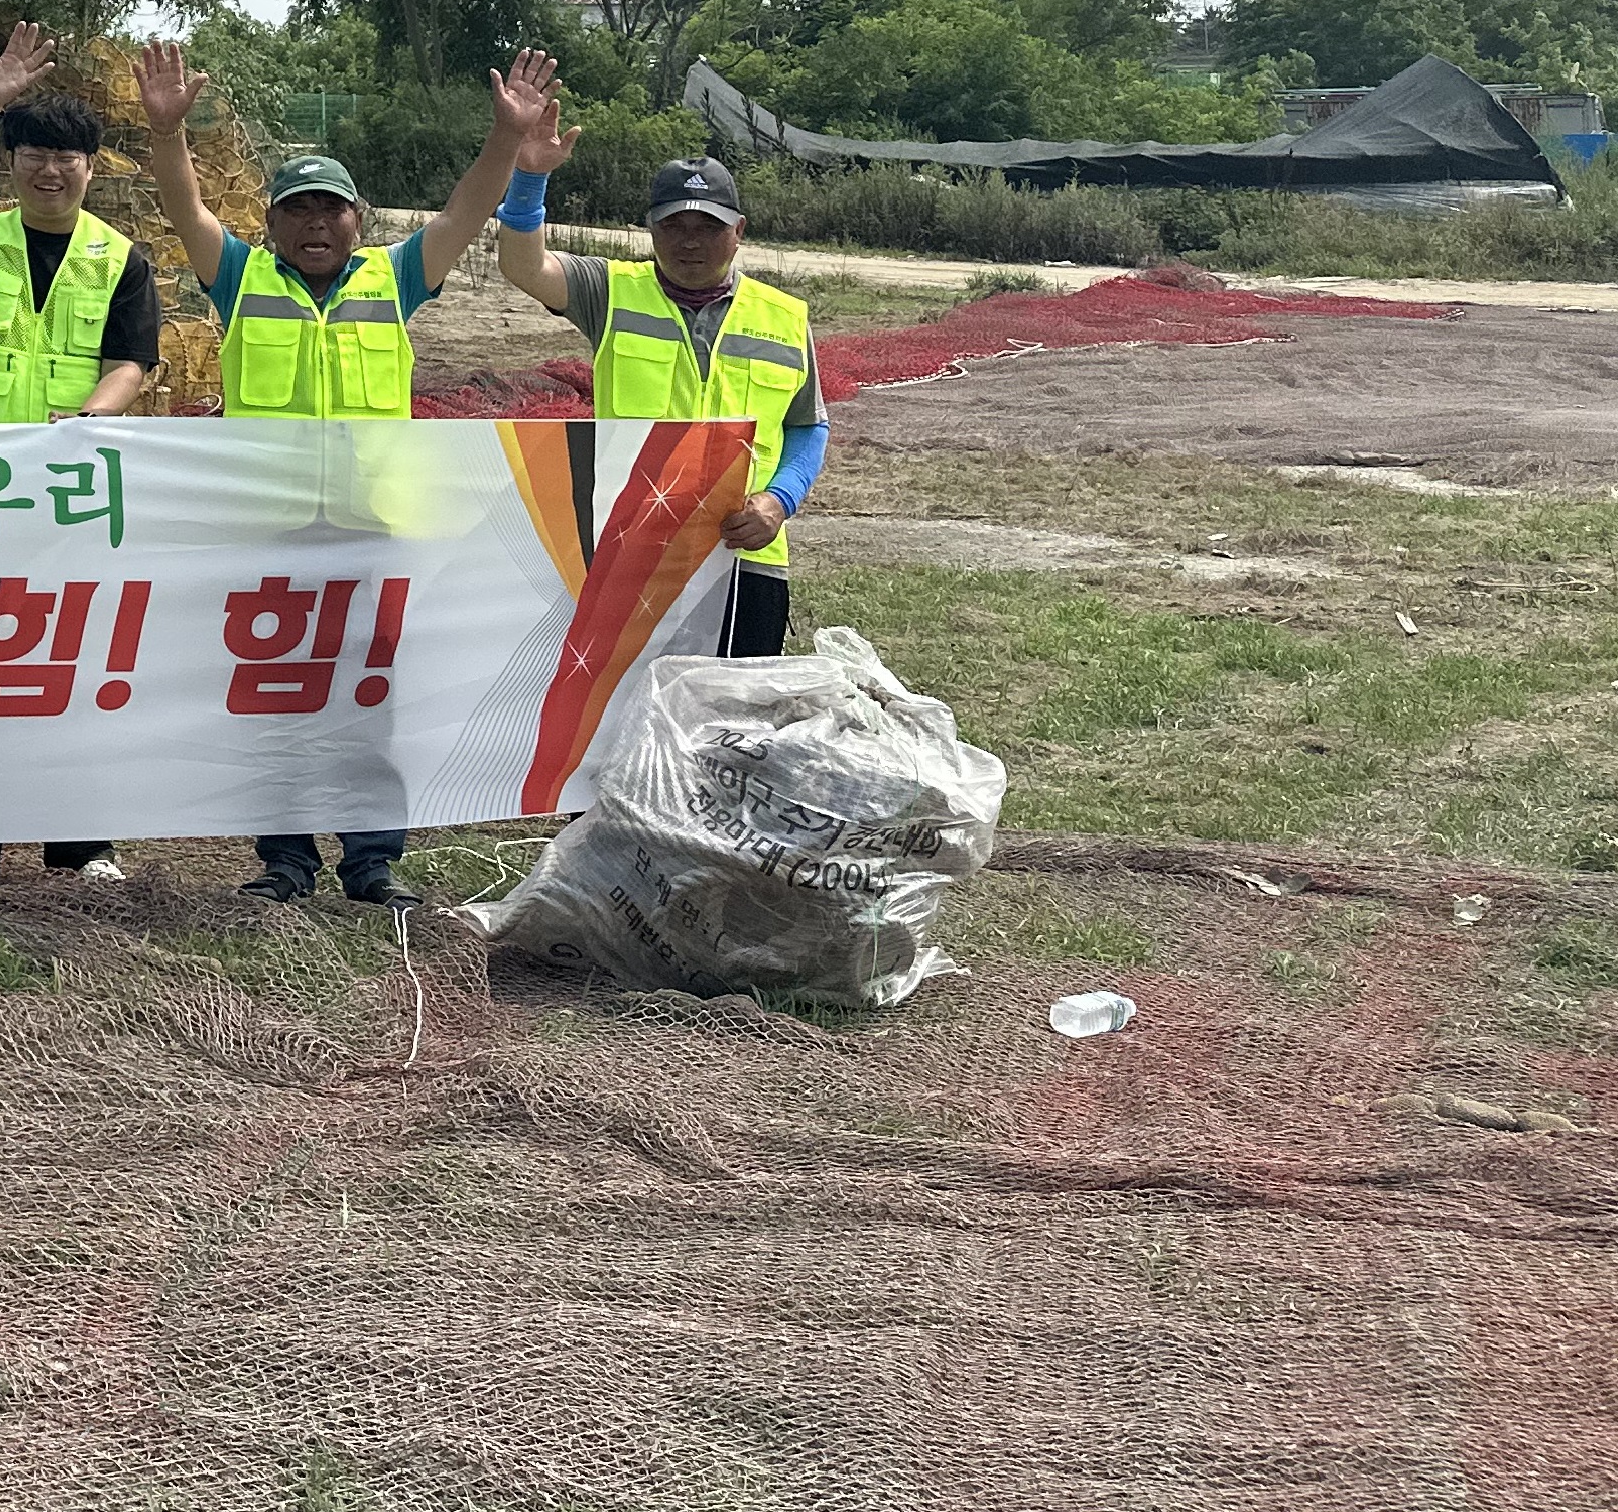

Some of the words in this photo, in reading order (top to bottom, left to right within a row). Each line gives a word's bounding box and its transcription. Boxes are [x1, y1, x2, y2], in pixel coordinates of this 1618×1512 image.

[223, 576, 411, 717] 힘!
[705, 728, 774, 761] 2025
[687, 784, 786, 877] 전용마대
[609, 884, 678, 966] 마대번호
